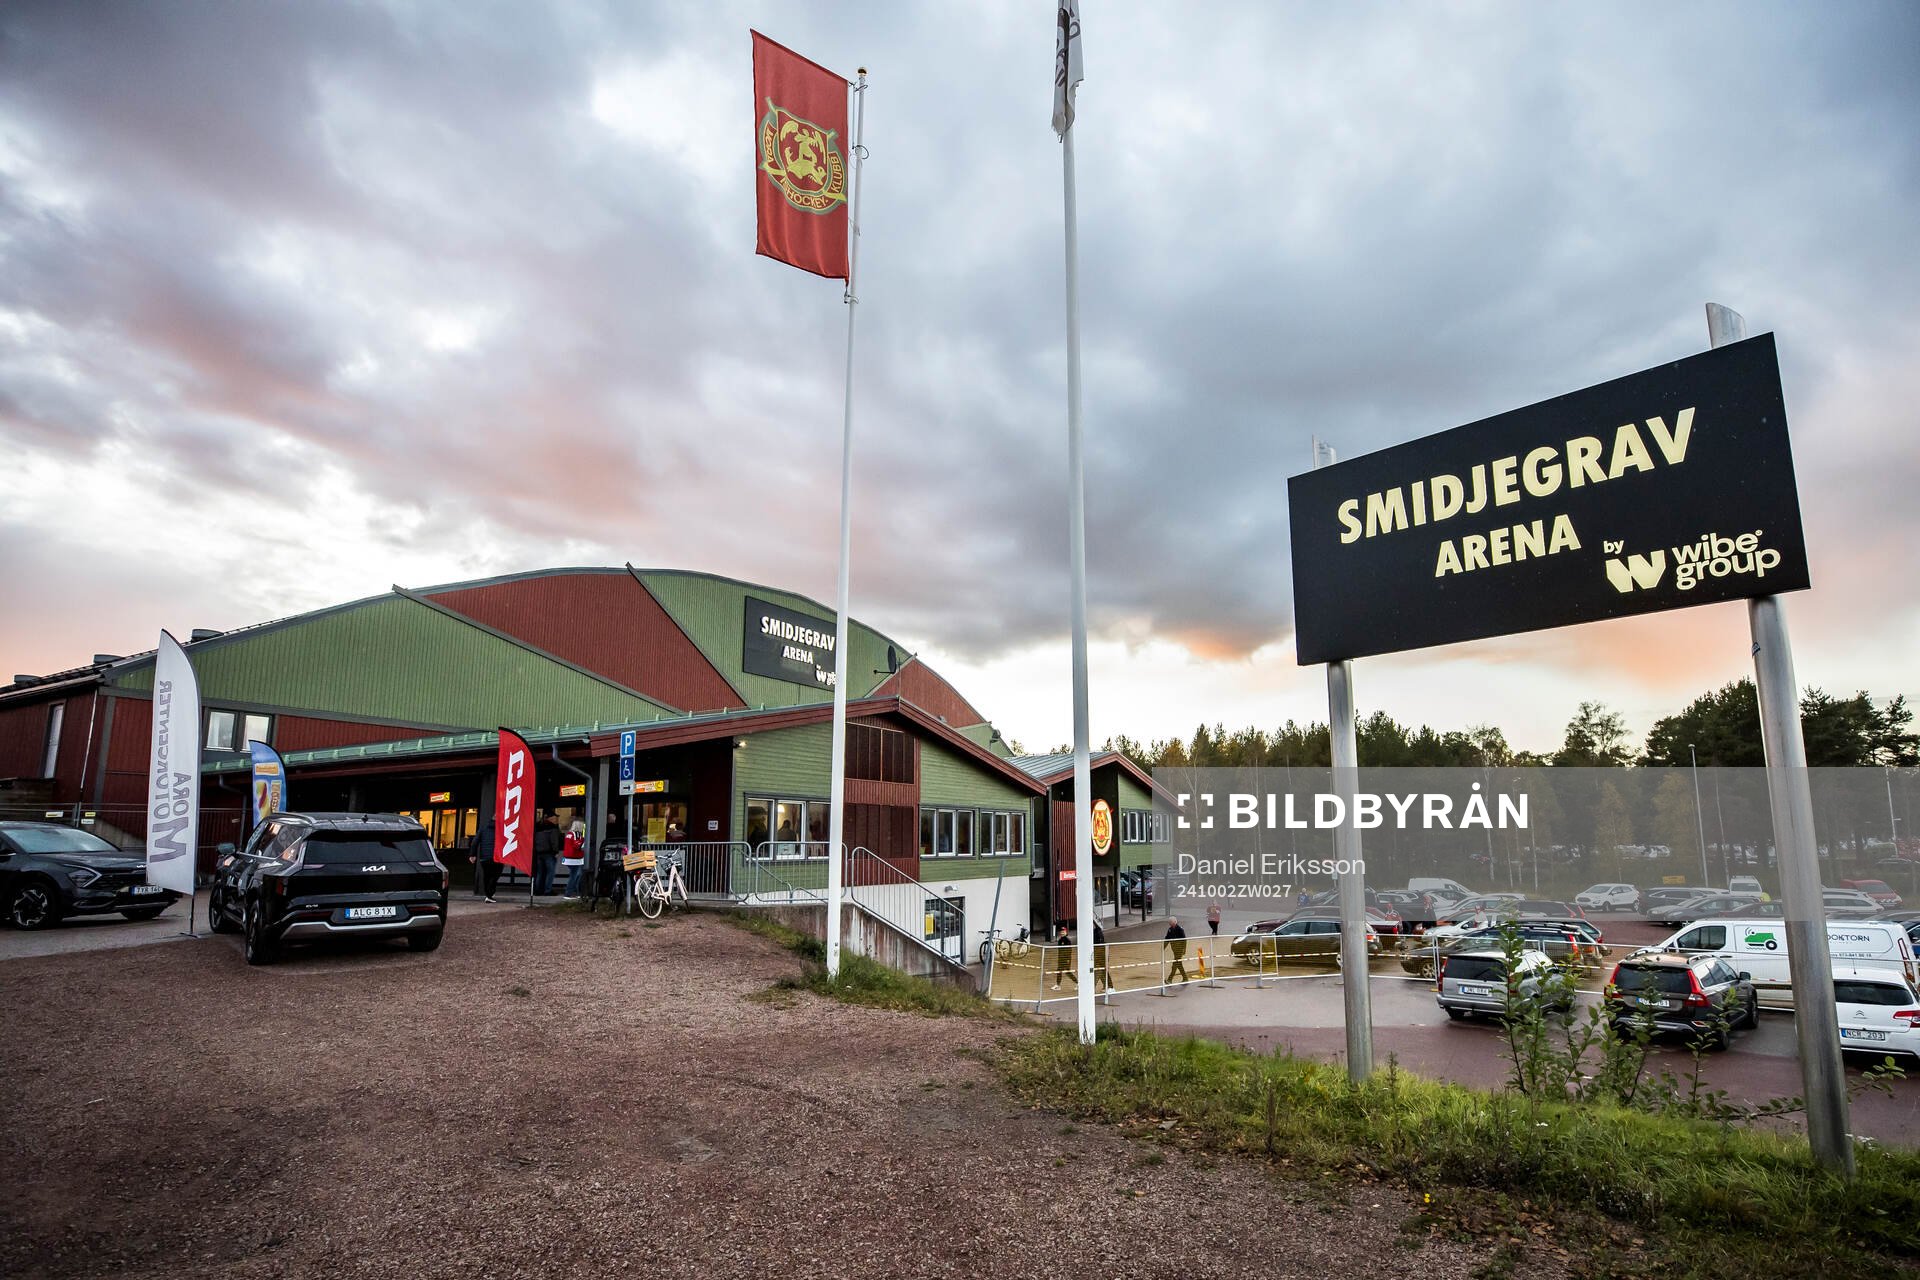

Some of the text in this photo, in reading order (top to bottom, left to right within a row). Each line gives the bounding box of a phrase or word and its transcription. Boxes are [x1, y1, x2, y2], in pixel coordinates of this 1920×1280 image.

[830, 155, 843, 193] KLUBB
[1337, 406, 1696, 544] SMIDJEGRAV
[1434, 513, 1582, 578] ARENA
[1603, 539, 1625, 555] by
[1675, 548, 1782, 591] group
[761, 616, 836, 651] SMIDJEGRAV
[782, 645, 814, 665] ARENA
[624, 734, 632, 754] P
[353, 906, 393, 917] ALG 81X
[1845, 1029, 1884, 1040] NCR 203
